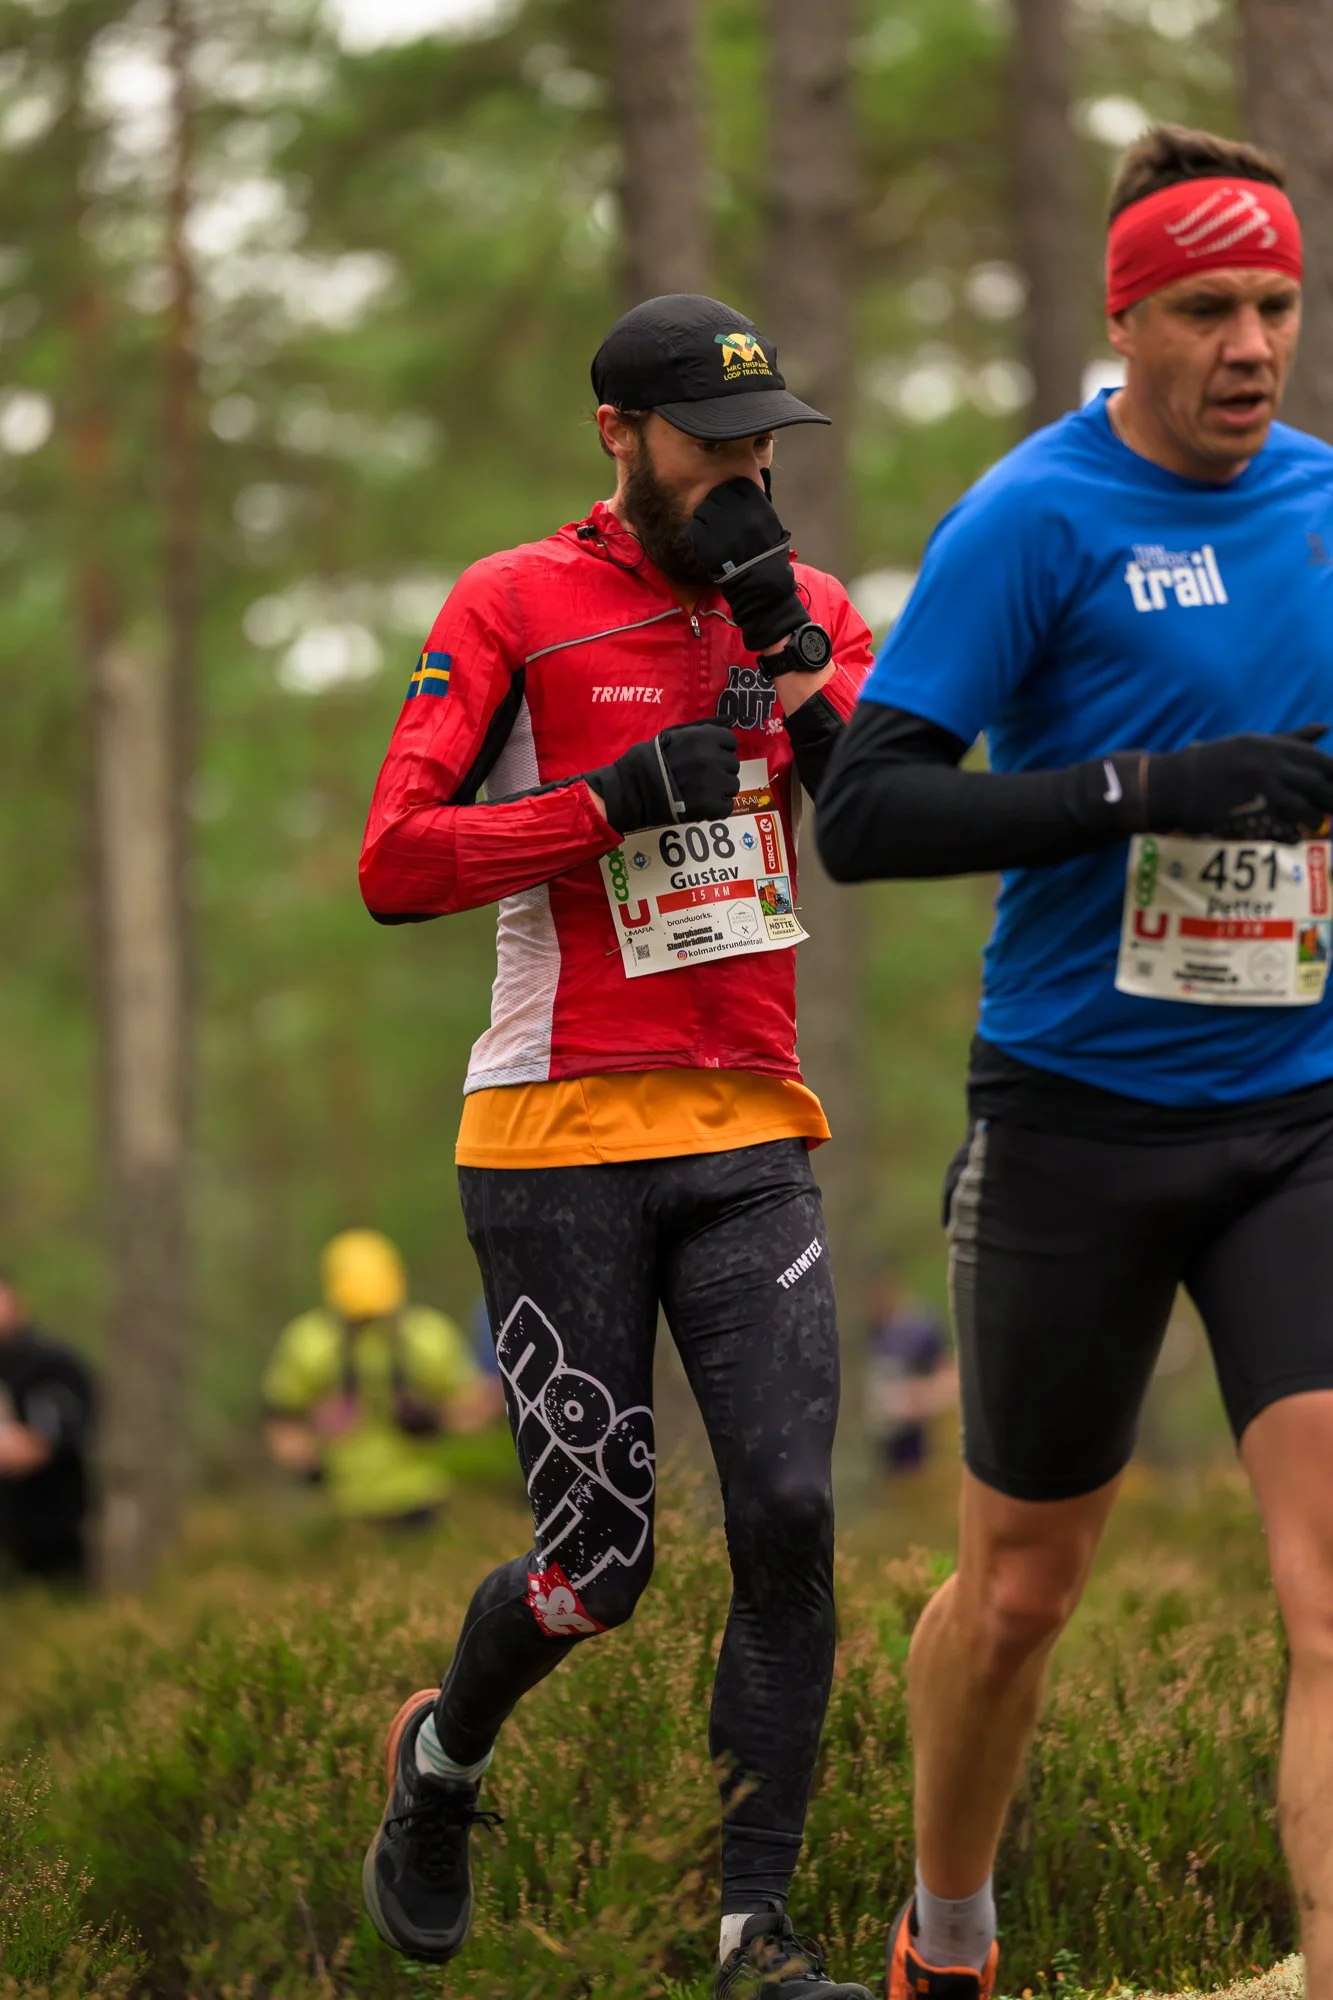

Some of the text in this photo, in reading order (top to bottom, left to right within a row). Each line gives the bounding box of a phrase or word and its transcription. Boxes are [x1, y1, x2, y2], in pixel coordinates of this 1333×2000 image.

[723, 371, 741, 381] LOOP
[1124, 544, 1229, 613] trail
[591, 686, 664, 704] TRIMTEX
[659, 822, 736, 868] 608
[764, 834, 776, 870] CIRCLE
[670, 866, 739, 890] Gustav
[1201, 847, 1279, 891] 451
[691, 885, 730, 902] 15 KM
[617, 898, 651, 929] U
[624, 926, 655, 937] UMARA
[673, 926, 713, 940] Borghamns
[714, 932, 724, 941] AB
[688, 938, 764, 958] kolmardsrundantrail
[776, 1236, 823, 1289] TRIMTEX
